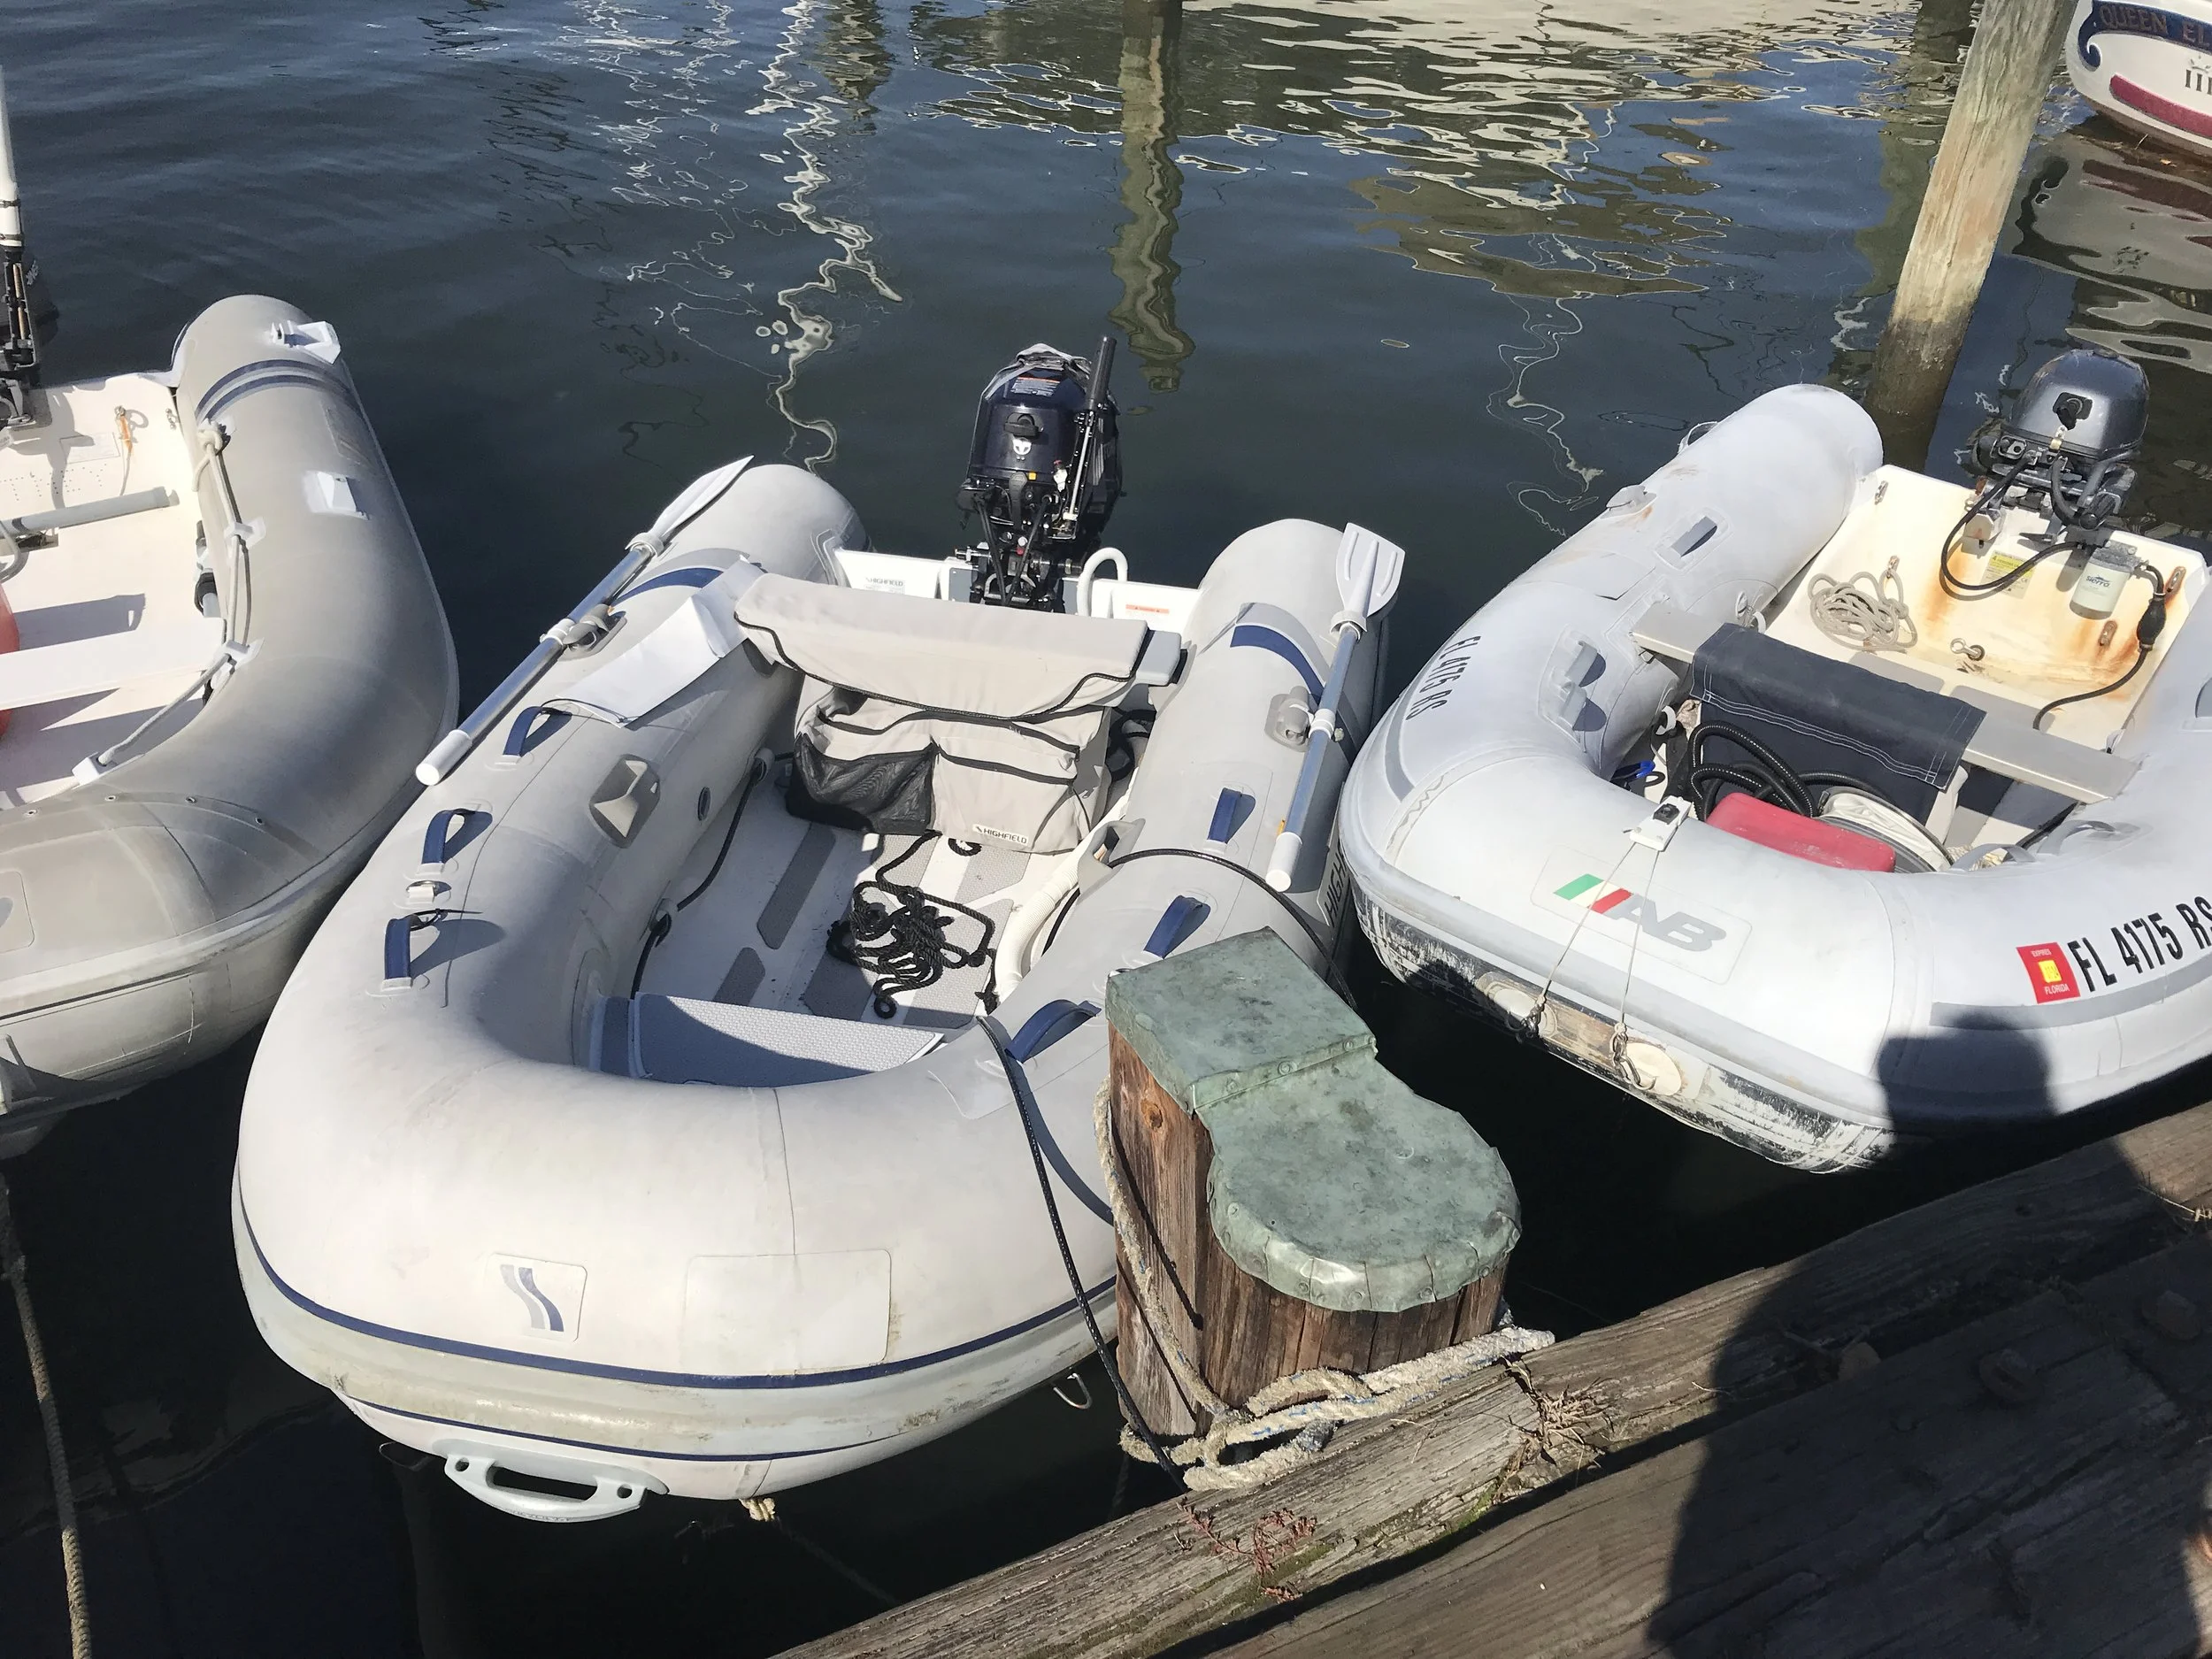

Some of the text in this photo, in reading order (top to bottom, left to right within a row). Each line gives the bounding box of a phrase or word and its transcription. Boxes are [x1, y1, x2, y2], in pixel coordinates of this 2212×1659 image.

[2099, 4, 2169, 35] QUEEN
[1405, 636, 1481, 720] FL 4175 RS
[983, 827, 1027, 844] HIGHFIELD
[1602, 893, 1727, 952] AB
[2067, 937, 2117, 992] FL
[2110, 912, 2183, 974] 4175
[2044, 984, 2070, 995] FLORIDA
